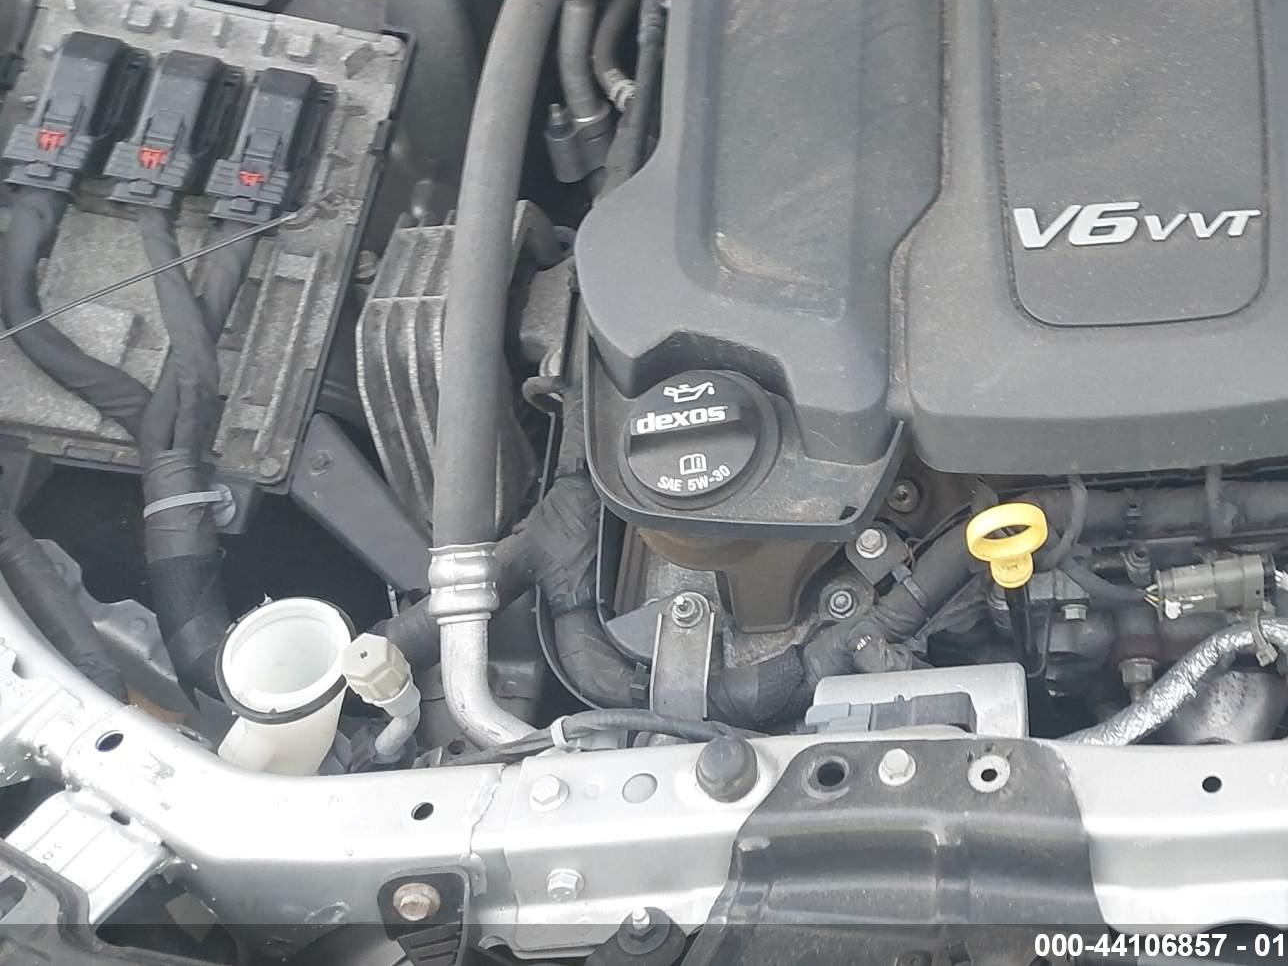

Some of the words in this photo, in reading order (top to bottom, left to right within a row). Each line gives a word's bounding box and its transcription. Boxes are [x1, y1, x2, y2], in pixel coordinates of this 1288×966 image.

[1012, 201, 1141, 249] V6
[1143, 208, 1263, 242] VVT
[635, 405, 729, 435] dexos
[656, 474, 683, 493] SAE
[686, 463, 732, 492] 5W-30
